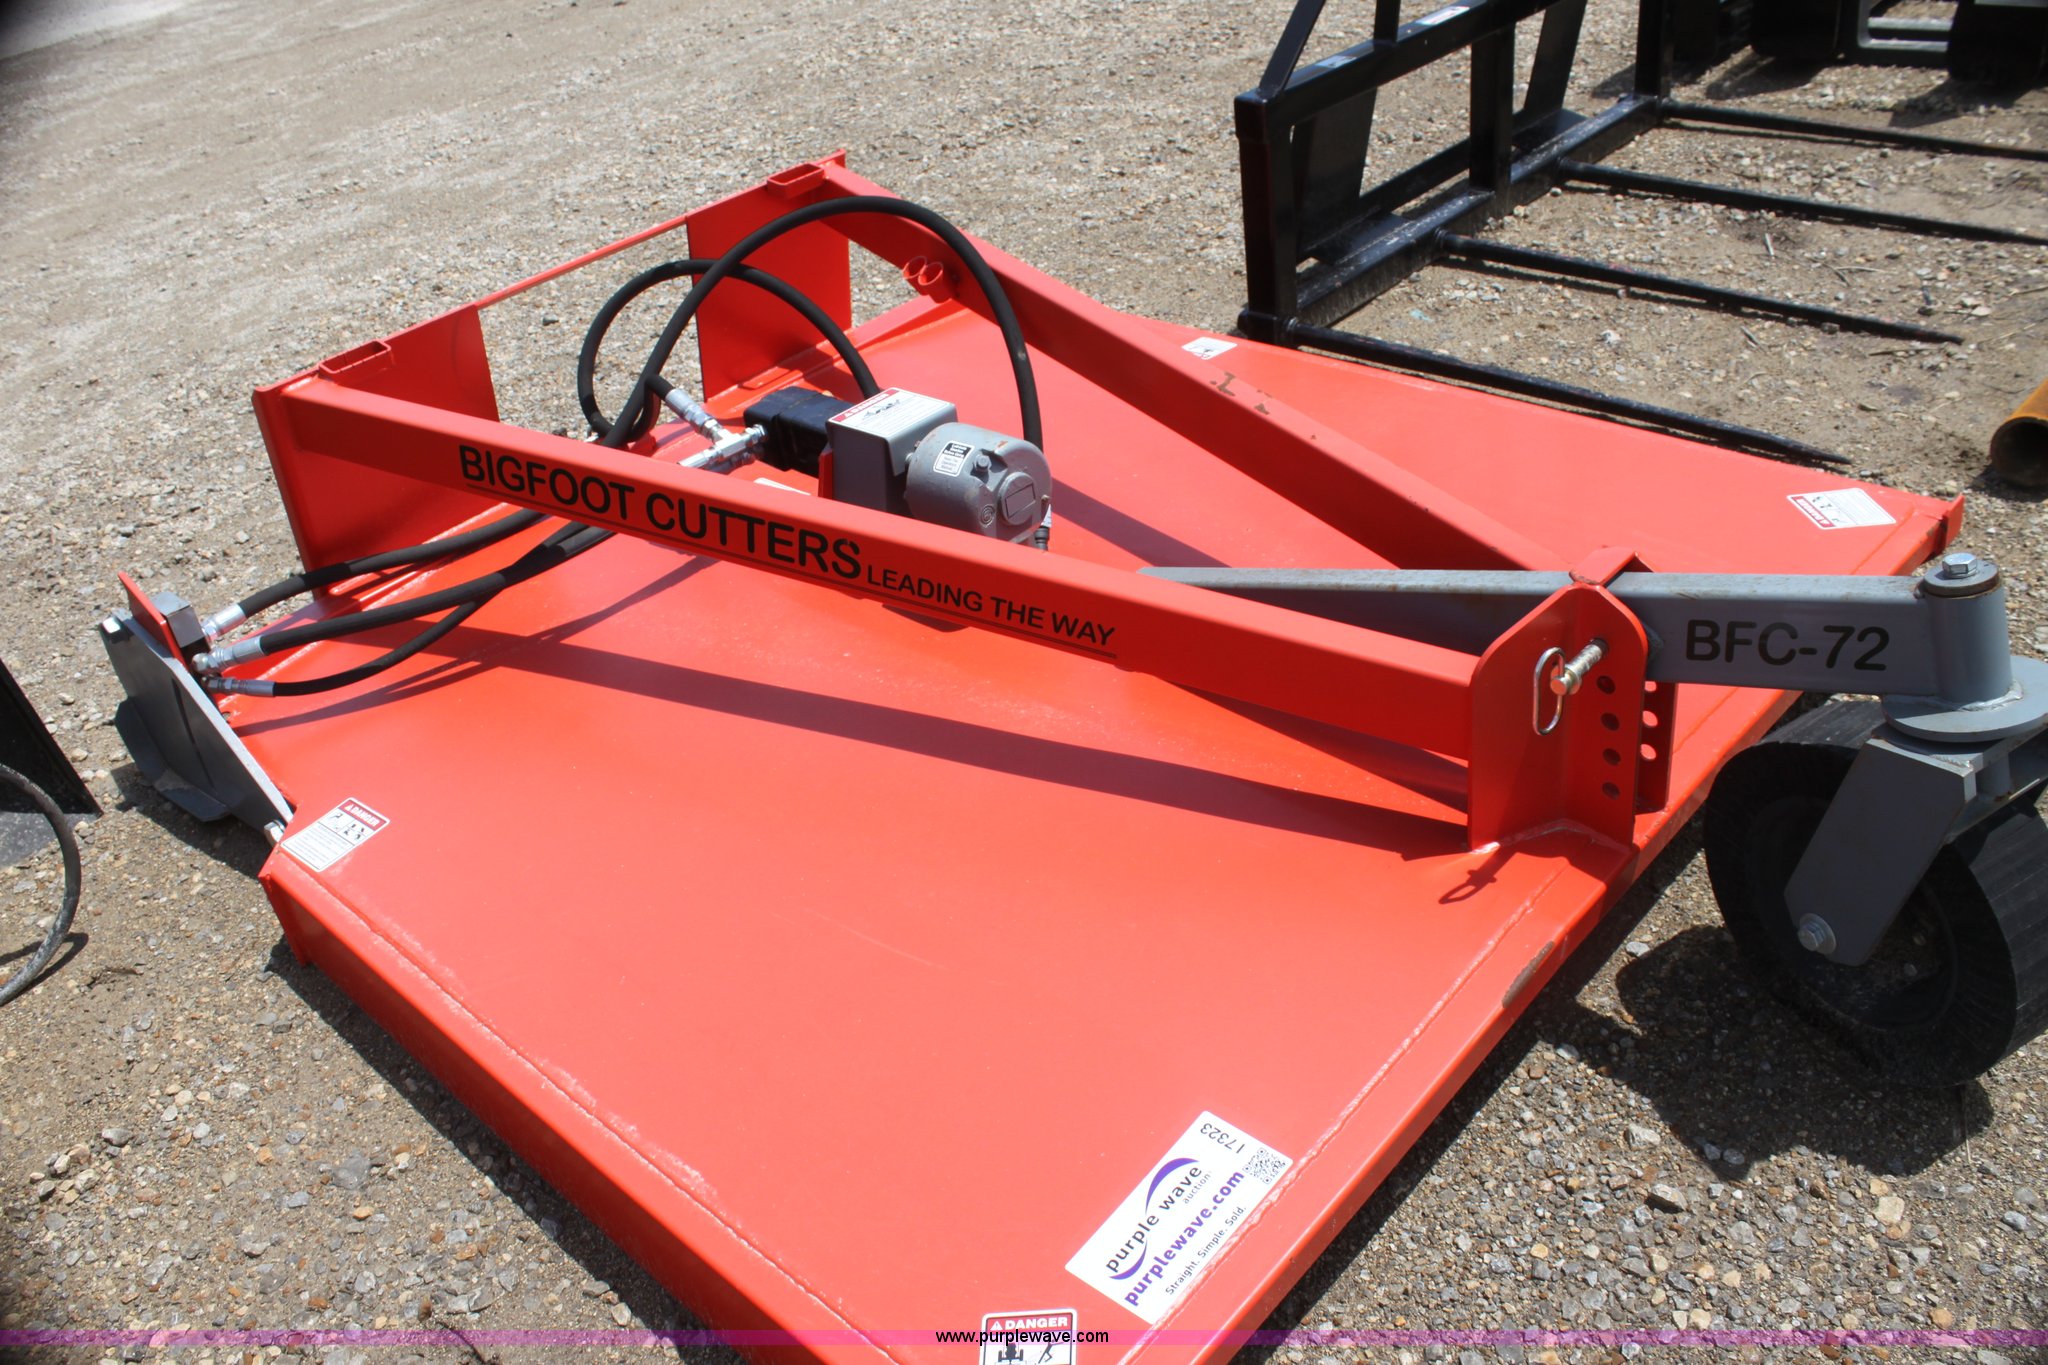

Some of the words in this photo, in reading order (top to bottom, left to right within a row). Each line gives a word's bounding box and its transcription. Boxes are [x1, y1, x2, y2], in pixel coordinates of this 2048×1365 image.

[459, 444, 635, 520] BIGFOOT
[646, 493, 862, 580] CUTTERS
[867, 565, 983, 612] LEADING
[990, 596, 1046, 629] THE
[1051, 612, 1115, 646] WAY
[1685, 619, 1890, 671] BFC-72
[1105, 1214, 1160, 1273] purple
[1158, 1166, 1202, 1212] wave
[1183, 1173, 1211, 1204] auction
[1124, 1171, 1245, 1307] purplewave.com
[1165, 1260, 1200, 1295] Straight.
[1197, 1228, 1228, 1259] Simple.
[1225, 1206, 1247, 1227] Sold.
[1004, 1316, 1068, 1331] DANGER
